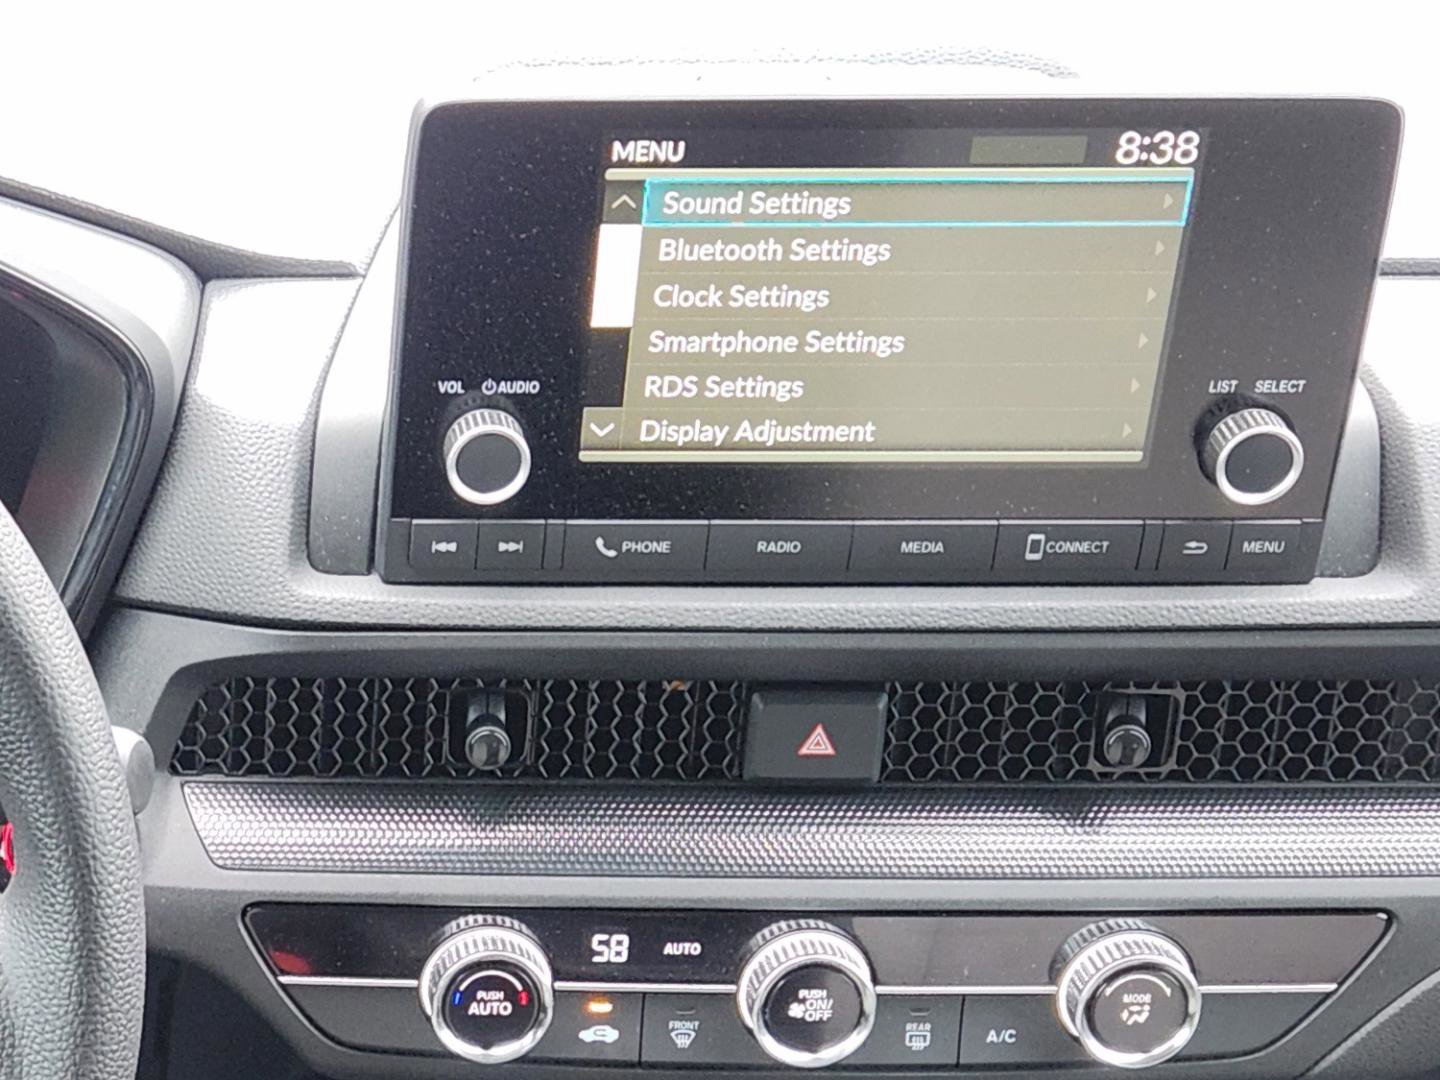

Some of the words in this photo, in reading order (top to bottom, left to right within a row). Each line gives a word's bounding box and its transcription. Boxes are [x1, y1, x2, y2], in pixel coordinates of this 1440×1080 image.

[611, 140, 685, 163] MENU
[1115, 131, 1200, 165] 8:38
[662, 192, 743, 216] Sound
[749, 192, 852, 218] Settings
[658, 239, 782, 263] Bluetooth
[788, 239, 891, 266] Settings
[653, 285, 723, 309] Clock
[728, 285, 830, 312] Settings
[647, 331, 798, 358] Smartphone
[804, 331, 905, 358] Settings
[438, 381, 465, 394] VOL
[497, 381, 541, 395] AUDIO
[643, 375, 698, 399] RDS
[704, 375, 804, 402] Settings
[1209, 380, 1238, 393] LIST
[1254, 380, 1306, 393] SELECT
[639, 420, 728, 447] Display
[734, 420, 875, 446] Adjustment
[622, 541, 672, 555] PHONE
[757, 541, 801, 554] RADIO
[900, 541, 945, 554] MEDIA
[1046, 541, 1110, 555] CONNECT
[1242, 541, 1286, 554] MENU
[591, 934, 629, 963] 58
[663, 942, 702, 956] AUTO
[476, 990, 504, 1001] PUSH
[798, 989, 827, 999] PUSH
[1123, 993, 1152, 1004] MODE
[468, 1002, 512, 1017] AUTO
[805, 999, 834, 1010] ON/
[804, 1010, 833, 1021] OFF
[668, 1021, 700, 1031] FRONT
[905, 1022, 931, 1031] REAR
[986, 1029, 1017, 1044] A/C
